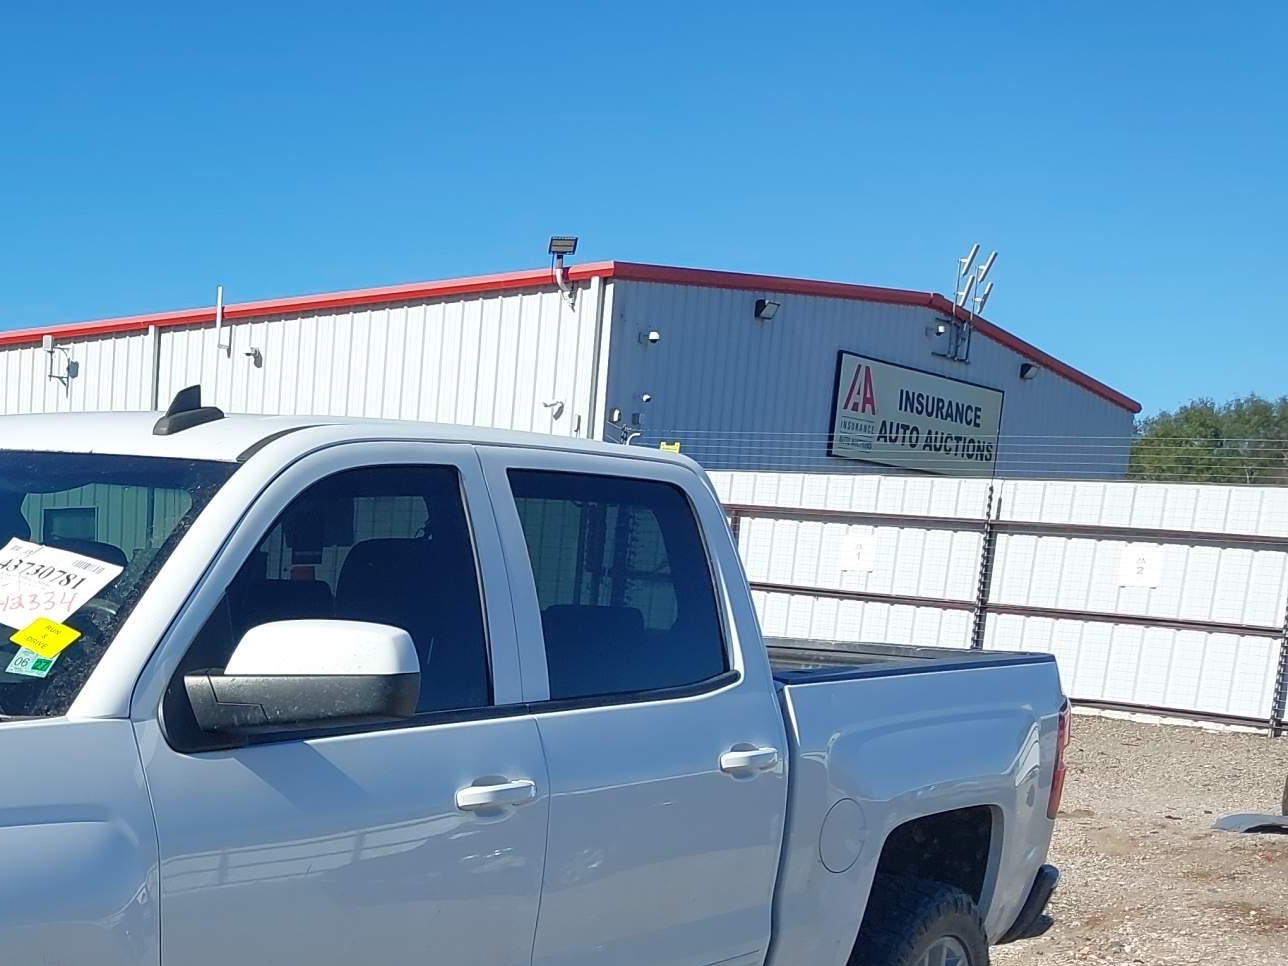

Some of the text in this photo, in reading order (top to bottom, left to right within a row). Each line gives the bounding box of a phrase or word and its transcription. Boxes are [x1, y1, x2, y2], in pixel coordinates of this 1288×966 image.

[899, 388, 982, 428] INSURANCE
[840, 419, 875, 434] INSURANCE
[876, 420, 920, 449] AUTO
[923, 429, 993, 462] AUCTIONS
[45, 624, 62, 636] RUN
[25, 636, 48, 650] DRIVE
[13, 656, 31, 668] 06
